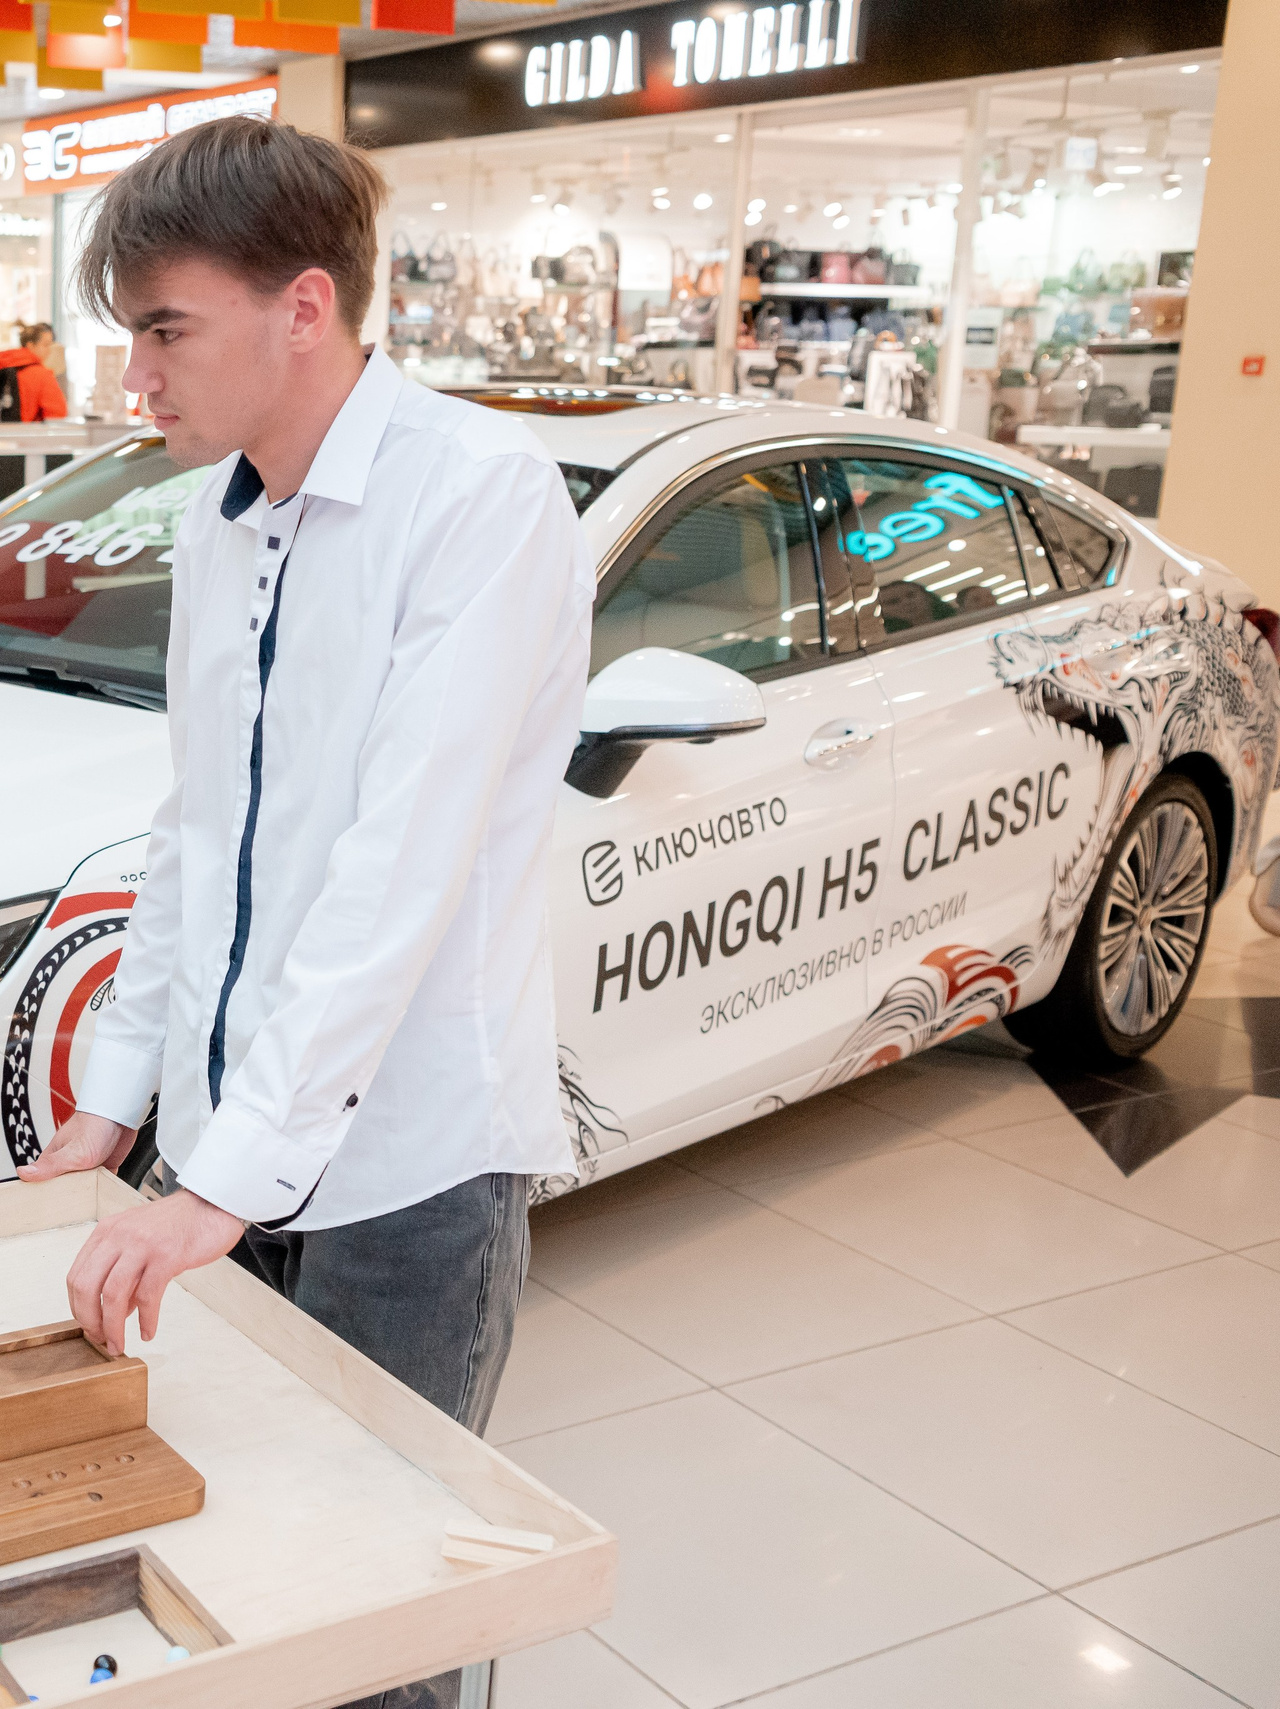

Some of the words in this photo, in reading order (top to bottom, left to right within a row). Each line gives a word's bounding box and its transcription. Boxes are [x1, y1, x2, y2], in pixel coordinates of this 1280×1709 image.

[524, 29, 636, 107] GILDA
[15, 519, 165, 567] 846
[591, 866, 806, 1014] HONGQI
[817, 836, 882, 920] H5
[901, 761, 1071, 883] CLASSIC
[698, 934, 867, 1035] ЭКСКЛЮЗИВНО
[870, 927, 886, 957] В
[887, 890, 968, 949] РОССИИ
